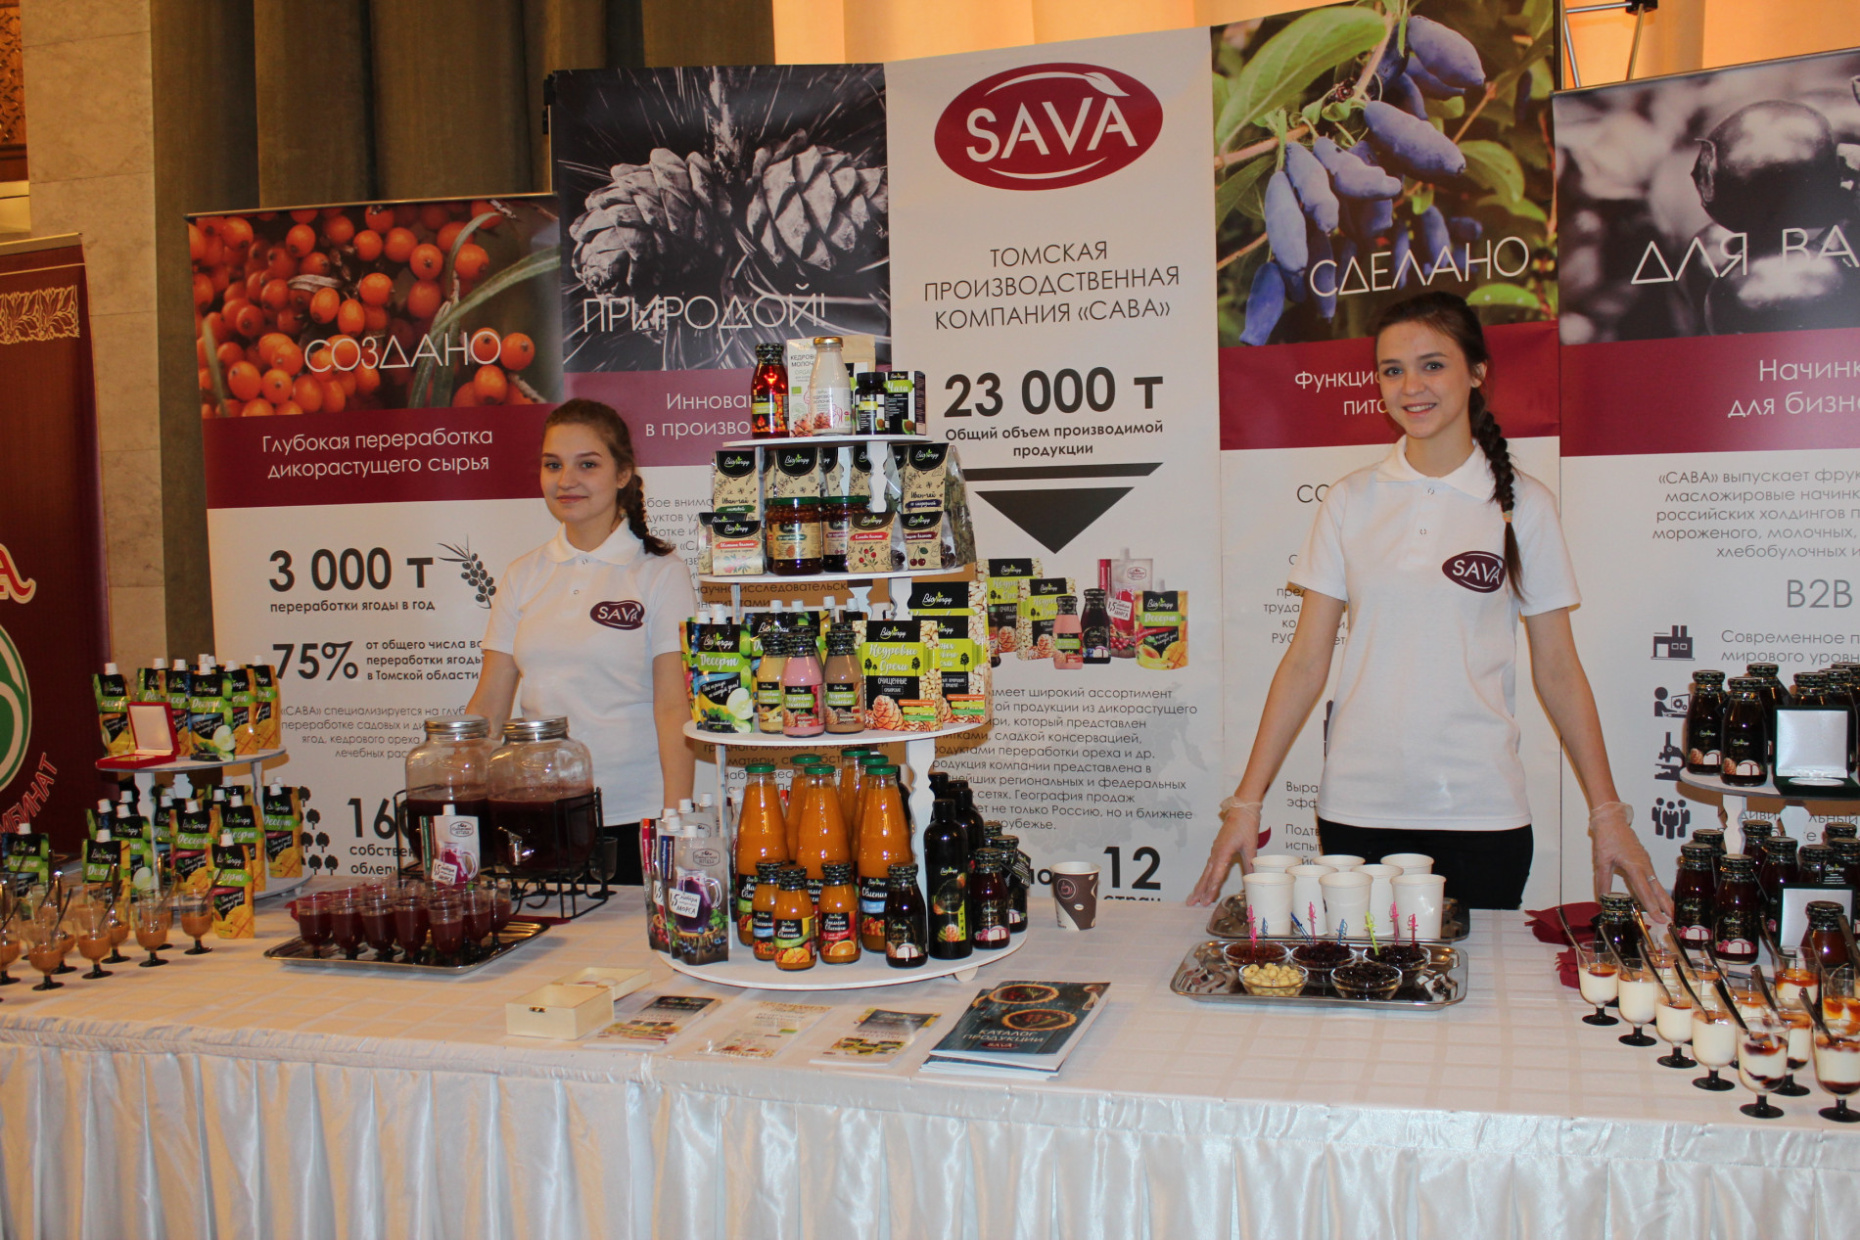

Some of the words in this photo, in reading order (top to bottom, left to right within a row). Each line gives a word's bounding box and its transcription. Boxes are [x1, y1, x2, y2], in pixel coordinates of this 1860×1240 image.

[966, 97, 1138, 162] SAVA
[990, 241, 1107, 268] ТОМСКАЯ
[1631, 232, 1748, 285] ДЛЯ
[1310, 236, 1529, 297] СДЕЛАНО
[925, 266, 1180, 302] ПРОИЗВОДСТВЕННАЯ
[936, 303, 1070, 330] КОМПАНИЯ
[1078, 298, 1170, 321] «САВА»
[305, 331, 501, 373] СОЗДАНО
[944, 372, 1004, 418] 23
[1021, 366, 1116, 415] 000
[1728, 398, 1775, 418] для
[646, 426, 655, 437] в
[945, 427, 998, 443] Общий
[1002, 425, 1050, 440] объем
[1053, 420, 1164, 439] производимой
[262, 434, 350, 455] Глубокая
[355, 427, 493, 451] переработка
[1013, 444, 1094, 458] продукции
[268, 457, 422, 479] дикорастущего
[428, 456, 490, 475] сырья
[1658, 471, 1718, 484] «САВА»
[1723, 471, 1809, 485] выпускает
[1665, 490, 1795, 503] масложировые
[1656, 507, 1755, 523] российских
[1759, 509, 1845, 520] холдингов
[1652, 528, 1762, 541] мороженого,
[1767, 528, 1857, 540] молочных,
[1716, 545, 1846, 559] хлебобулочных
[268, 550, 295, 592] 3
[311, 547, 392, 591] 000
[1452, 559, 1500, 585] SAVA
[1786, 579, 1853, 608] B2B
[270, 601, 358, 614] переработки
[362, 600, 399, 613] ягоды
[402, 601, 409, 610] в
[412, 600, 435, 611] год
[597, 606, 638, 622] SAVA
[1721, 629, 1845, 646] Современное
[366, 640, 378, 650] от
[382, 639, 425, 651] общего
[429, 640, 465, 649] числа
[272, 641, 359, 681] 75%
[366, 655, 443, 668] переработки
[1721, 652, 1804, 664] мирового
[367, 672, 373, 680] в
[376, 669, 423, 681] Томской
[426, 669, 479, 681] области
[1029, 687, 1085, 699] широкий
[1088, 689, 1172, 700] ассортимент
[324, 706, 422, 718] специализируется
[425, 707, 439, 716] на
[1013, 703, 1079, 713] продукции
[1083, 704, 1095, 713] из
[1098, 704, 1198, 716] дикорастущего
[281, 719, 354, 733] переработке
[356, 720, 401, 732] садовых
[403, 721, 410, 729] и
[1014, 717, 1064, 728] который
[1067, 718, 1146, 730] представлен
[302, 735, 327, 746] ягод,
[330, 734, 385, 746] кедрового
[388, 735, 420, 746] ореха
[995, 731, 1045, 742] сладкой
[1048, 733, 1142, 745] консервацией,
[335, 748, 385, 759] лечебных
[999, 746, 1079, 758] переработки
[1082, 748, 1121, 759] ореха
[1135, 750, 1155, 760] др.
[990, 761, 1051, 772] компании
[1054, 763, 1142, 775] представлена
[1146, 765, 1152, 773] в
[1000, 777, 1084, 787] региональных
[1098, 777, 1187, 790] федеральных
[978, 790, 1011, 800] сетях.
[1015, 790, 1083, 802] География
[1087, 793, 1135, 804] продаж
[992, 805, 1006, 814] не
[1010, 805, 1049, 815] только
[1052, 804, 1102, 817] Россию,
[1107, 809, 1122, 818] но
[1126, 810, 1133, 818] и
[1136, 808, 1193, 820] ближнее
[1104, 846, 1161, 890] 12
